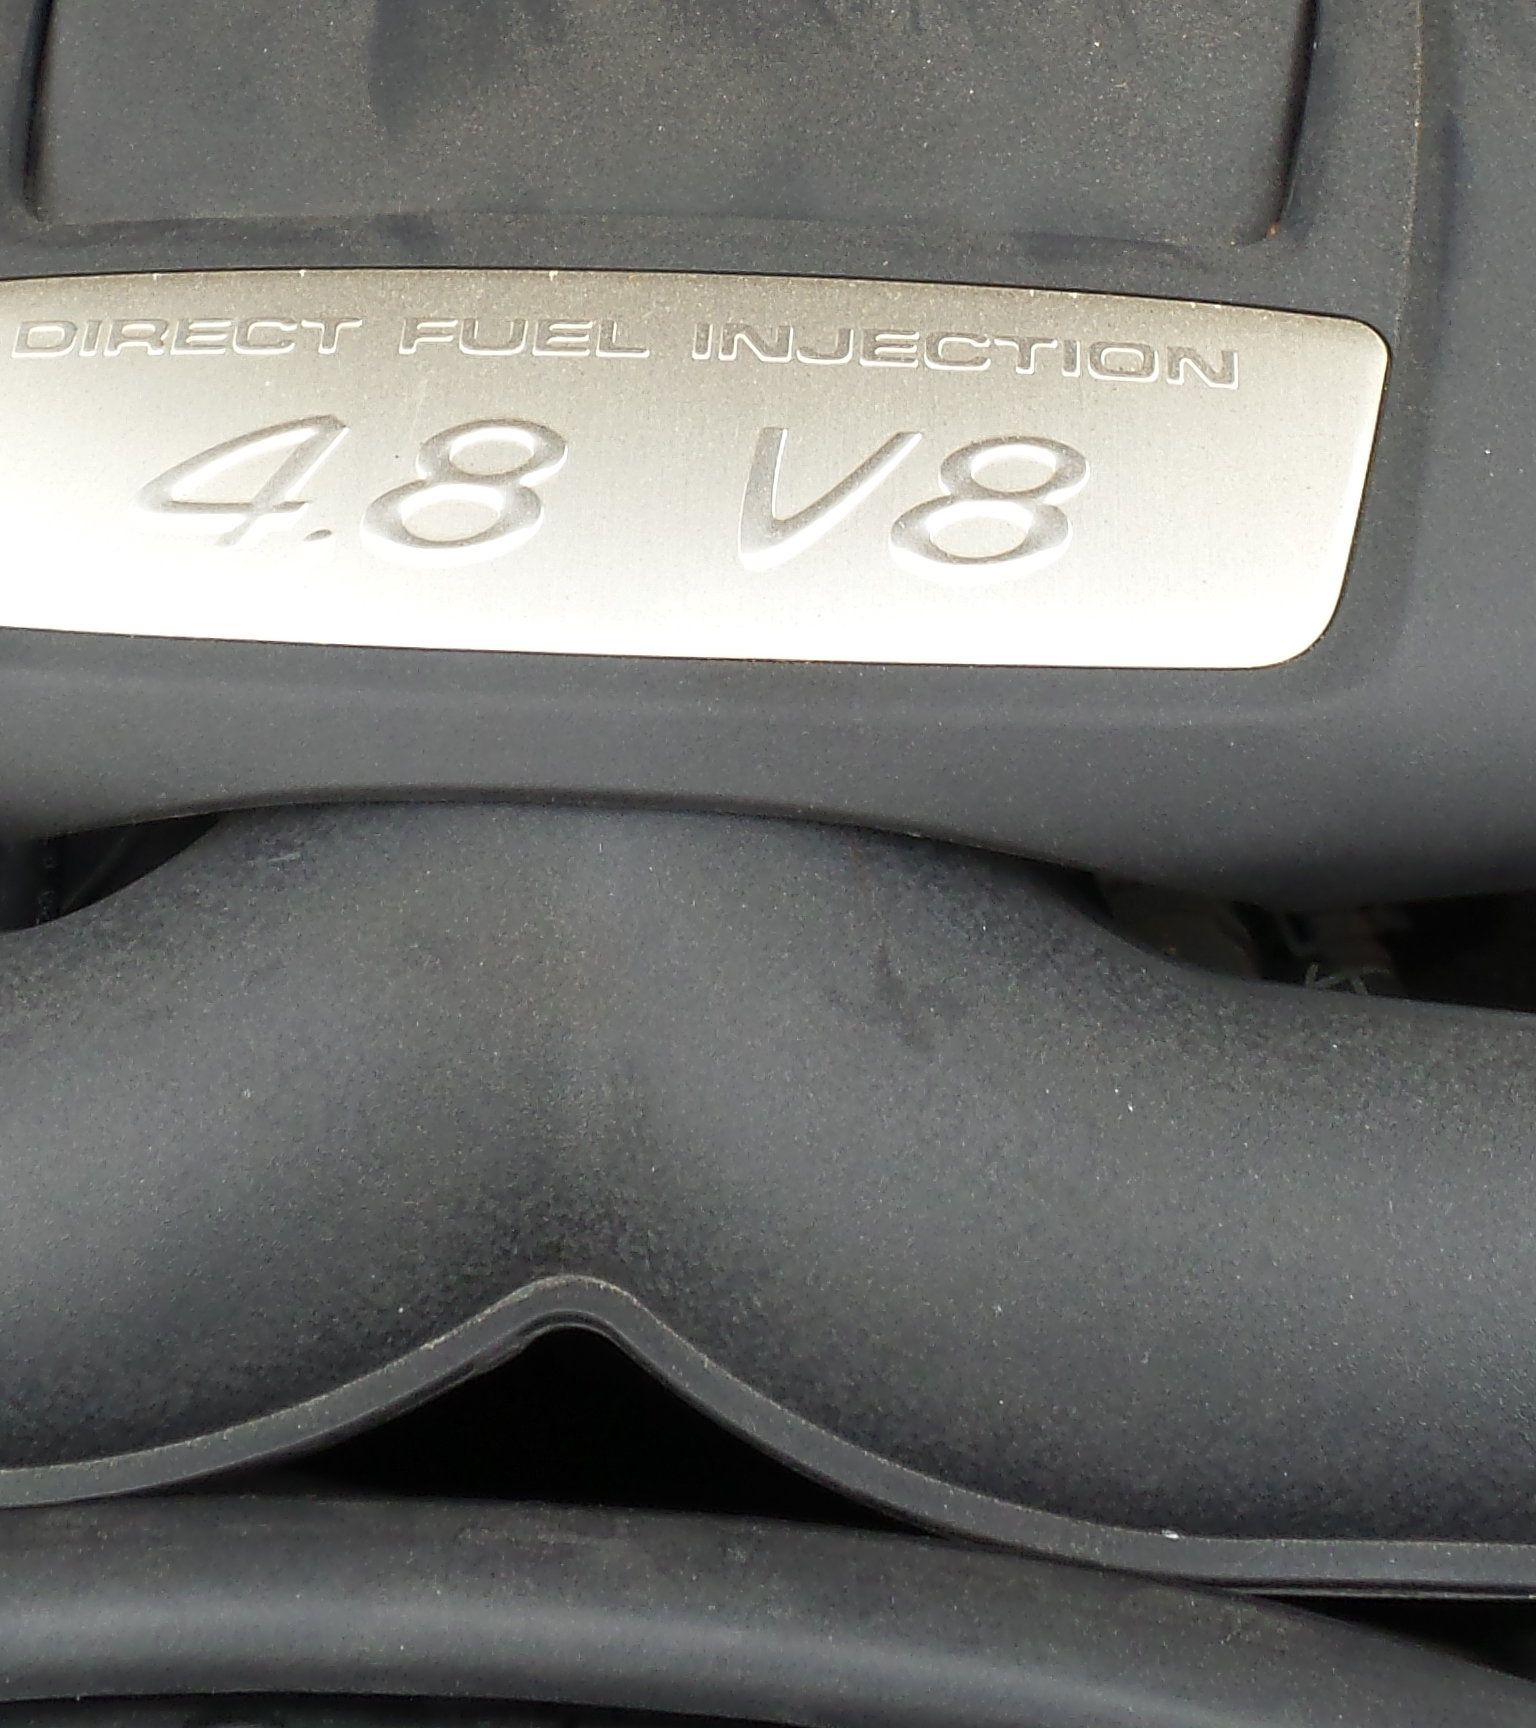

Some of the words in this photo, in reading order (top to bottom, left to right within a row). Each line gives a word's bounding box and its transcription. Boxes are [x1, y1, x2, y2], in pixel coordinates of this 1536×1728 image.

[11, 317, 363, 360] DIRECT
[397, 317, 652, 359] FUEL
[690, 322, 1241, 391] INJECTION
[134, 414, 570, 566] 4.8
[735, 426, 1091, 574] V8
